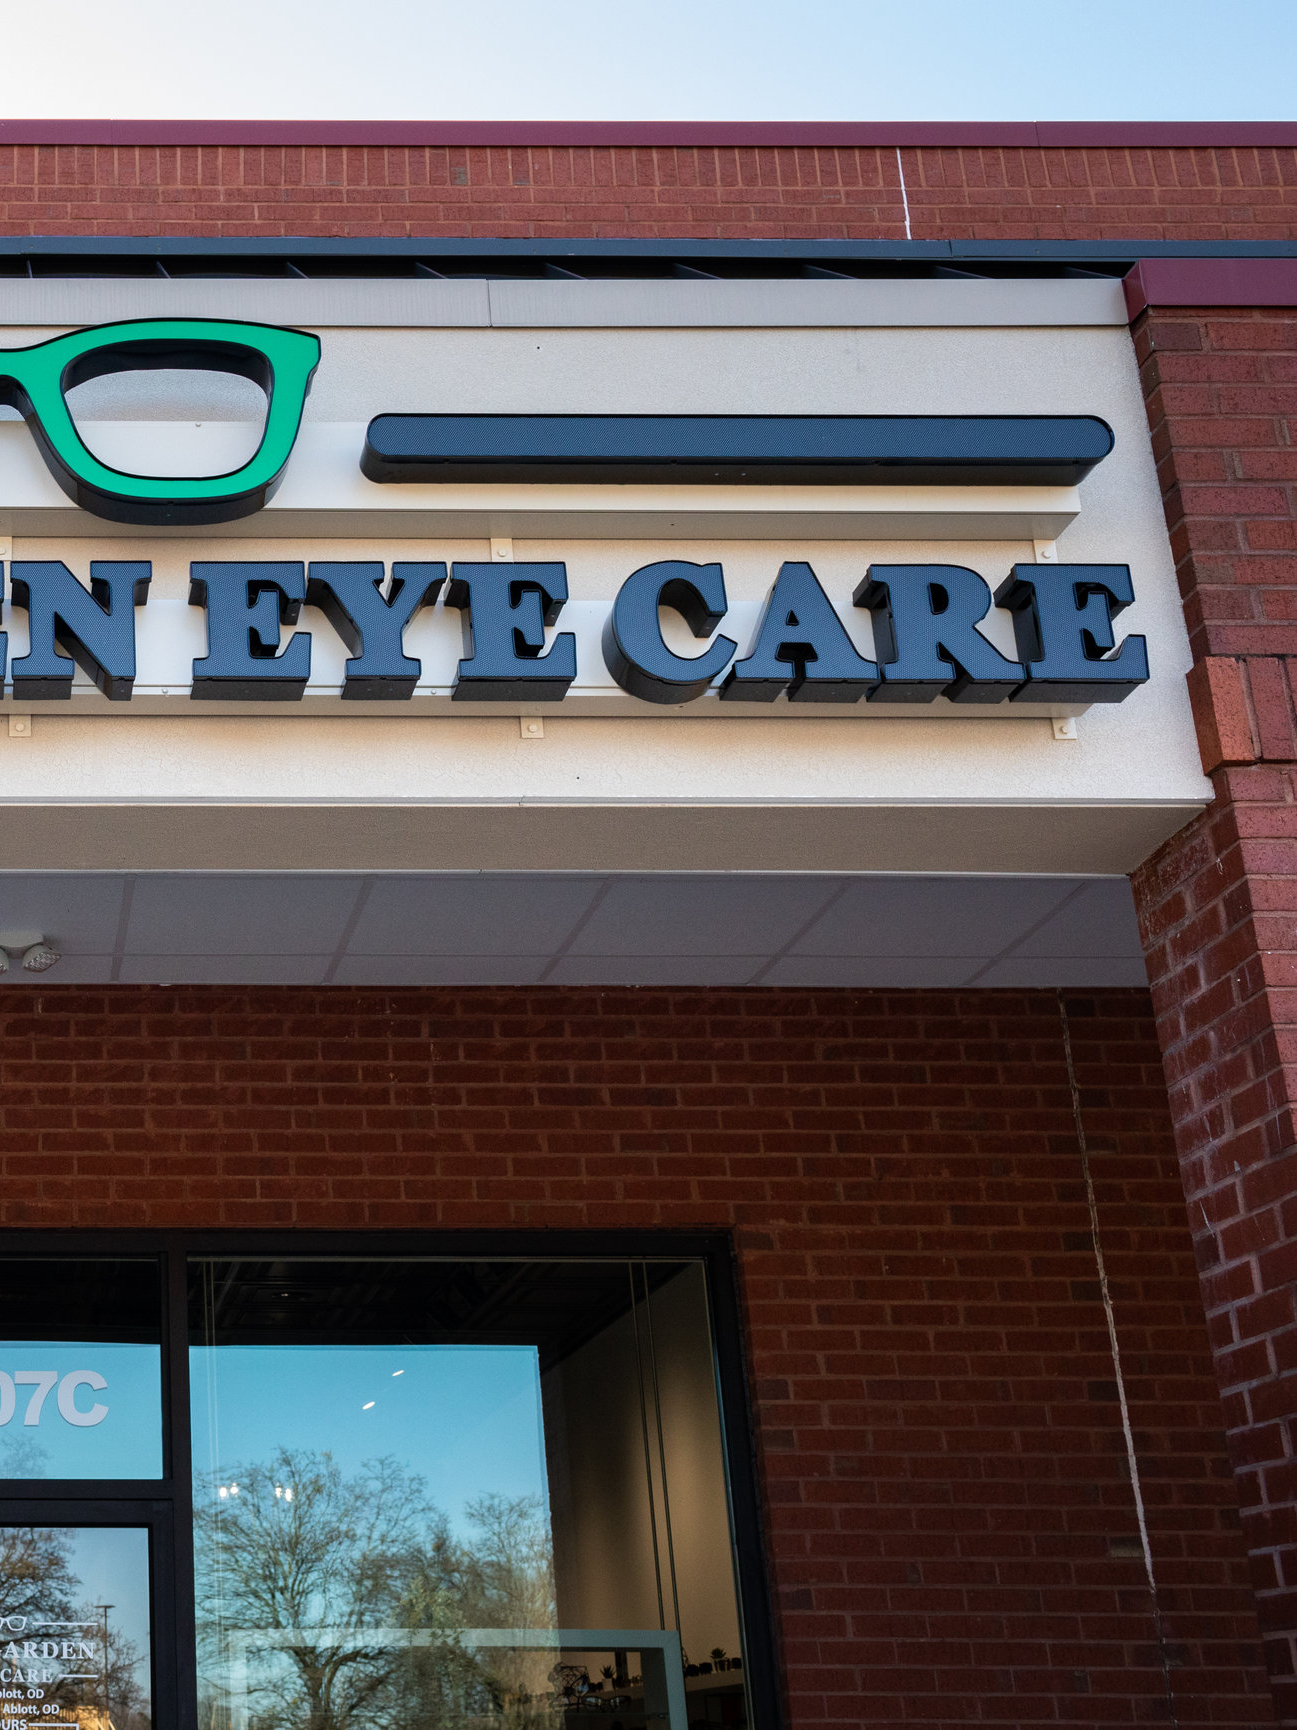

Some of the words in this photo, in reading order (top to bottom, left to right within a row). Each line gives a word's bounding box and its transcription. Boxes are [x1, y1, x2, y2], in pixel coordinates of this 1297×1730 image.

[189, 560, 577, 701] EYE
[602, 560, 1151, 703] CARE
[0, 1667, 54, 1684] CARE
[26, 1688, 45, 1700] OD
[2, 1703, 40, 1716] Ablott,
[41, 1703, 60, 1715] OD
